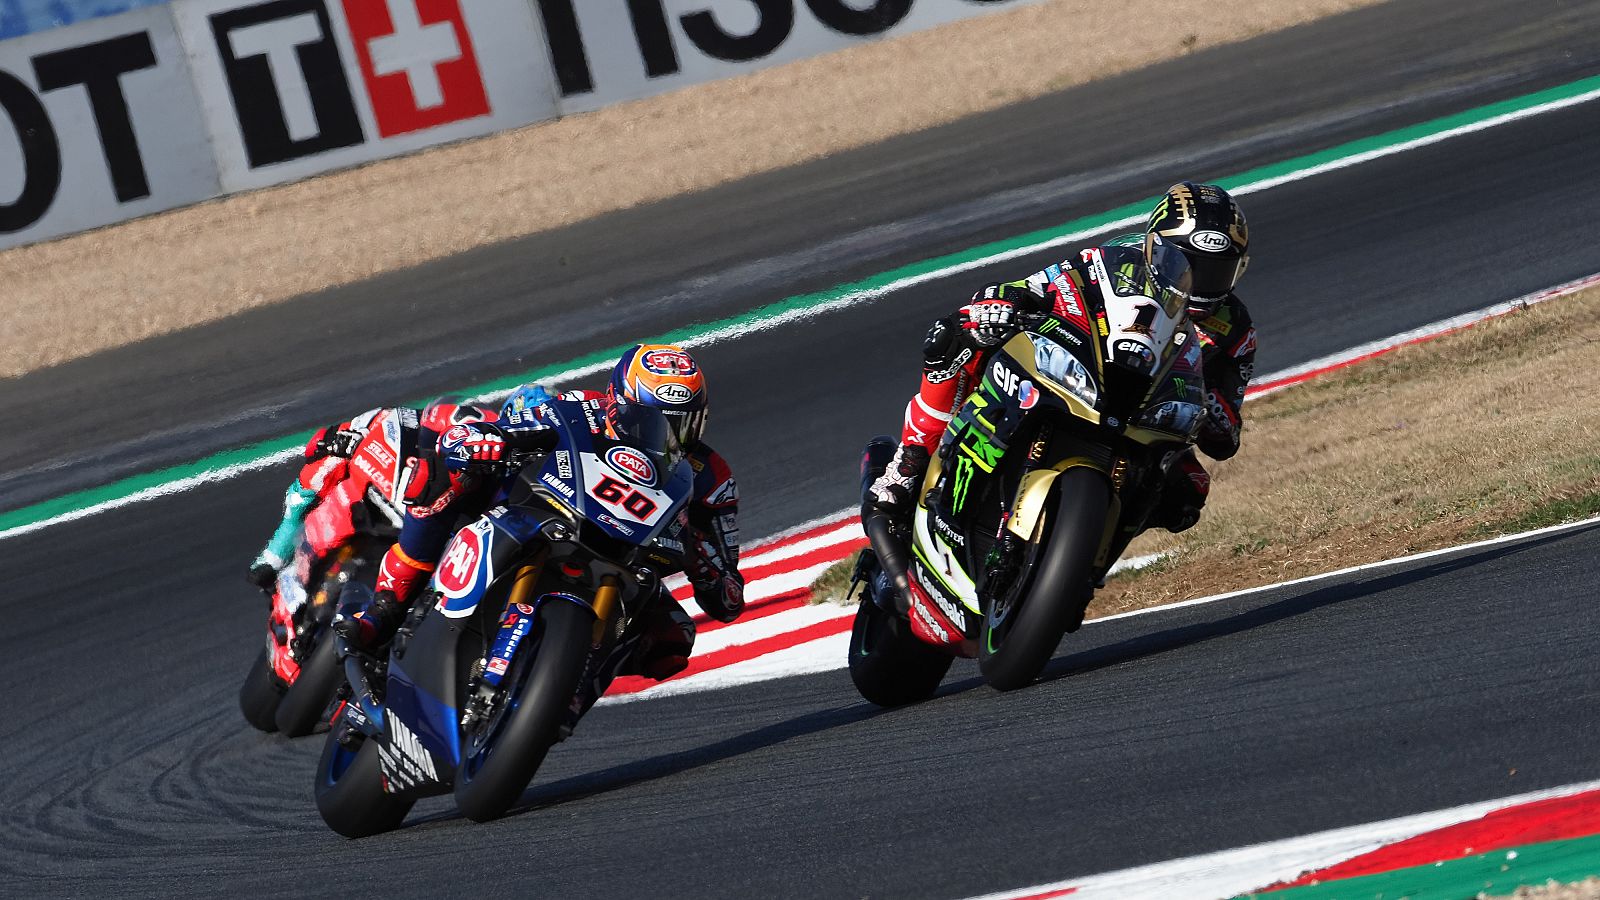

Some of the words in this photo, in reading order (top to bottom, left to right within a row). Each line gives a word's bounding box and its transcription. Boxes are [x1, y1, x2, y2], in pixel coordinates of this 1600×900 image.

[1197, 234, 1226, 247] Arai
[1117, 341, 1144, 354] elf
[992, 361, 1020, 397] elf
[659, 386, 688, 398] Arai
[618, 453, 648, 475] PATA
[541, 473, 575, 498] YAMAHA
[592, 473, 658, 522] 60
